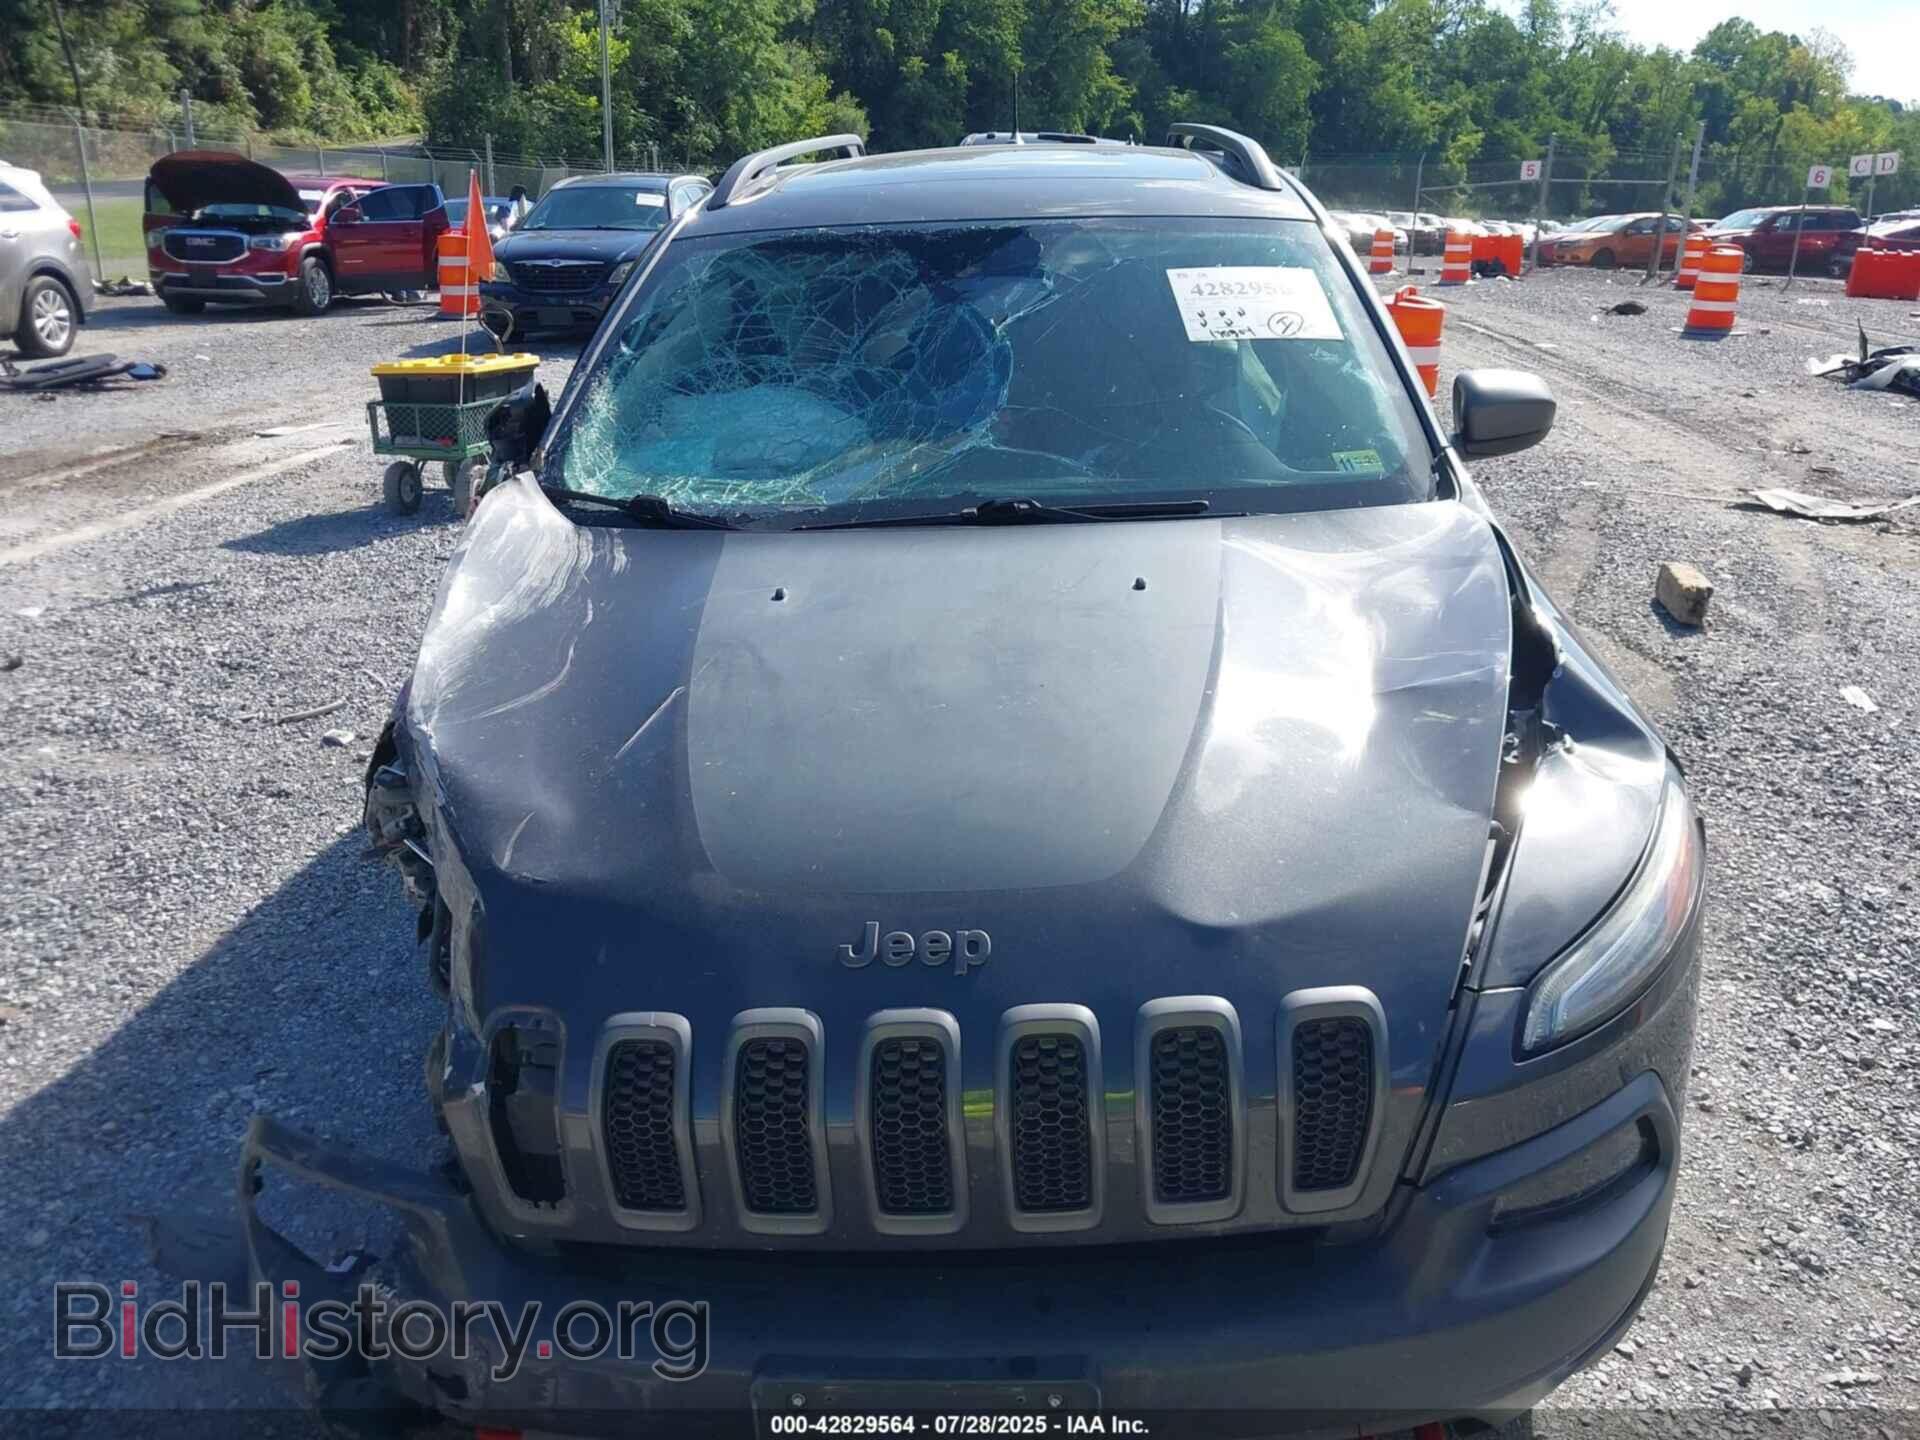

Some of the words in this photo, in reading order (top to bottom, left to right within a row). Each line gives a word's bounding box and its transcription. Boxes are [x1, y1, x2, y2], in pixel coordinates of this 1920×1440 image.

[1526, 163, 1537, 177] 5
[1854, 159, 1868, 174] C
[1880, 156, 1895, 171] D
[1813, 169, 1825, 184] 6
[838, 920, 992, 976] Jeep
